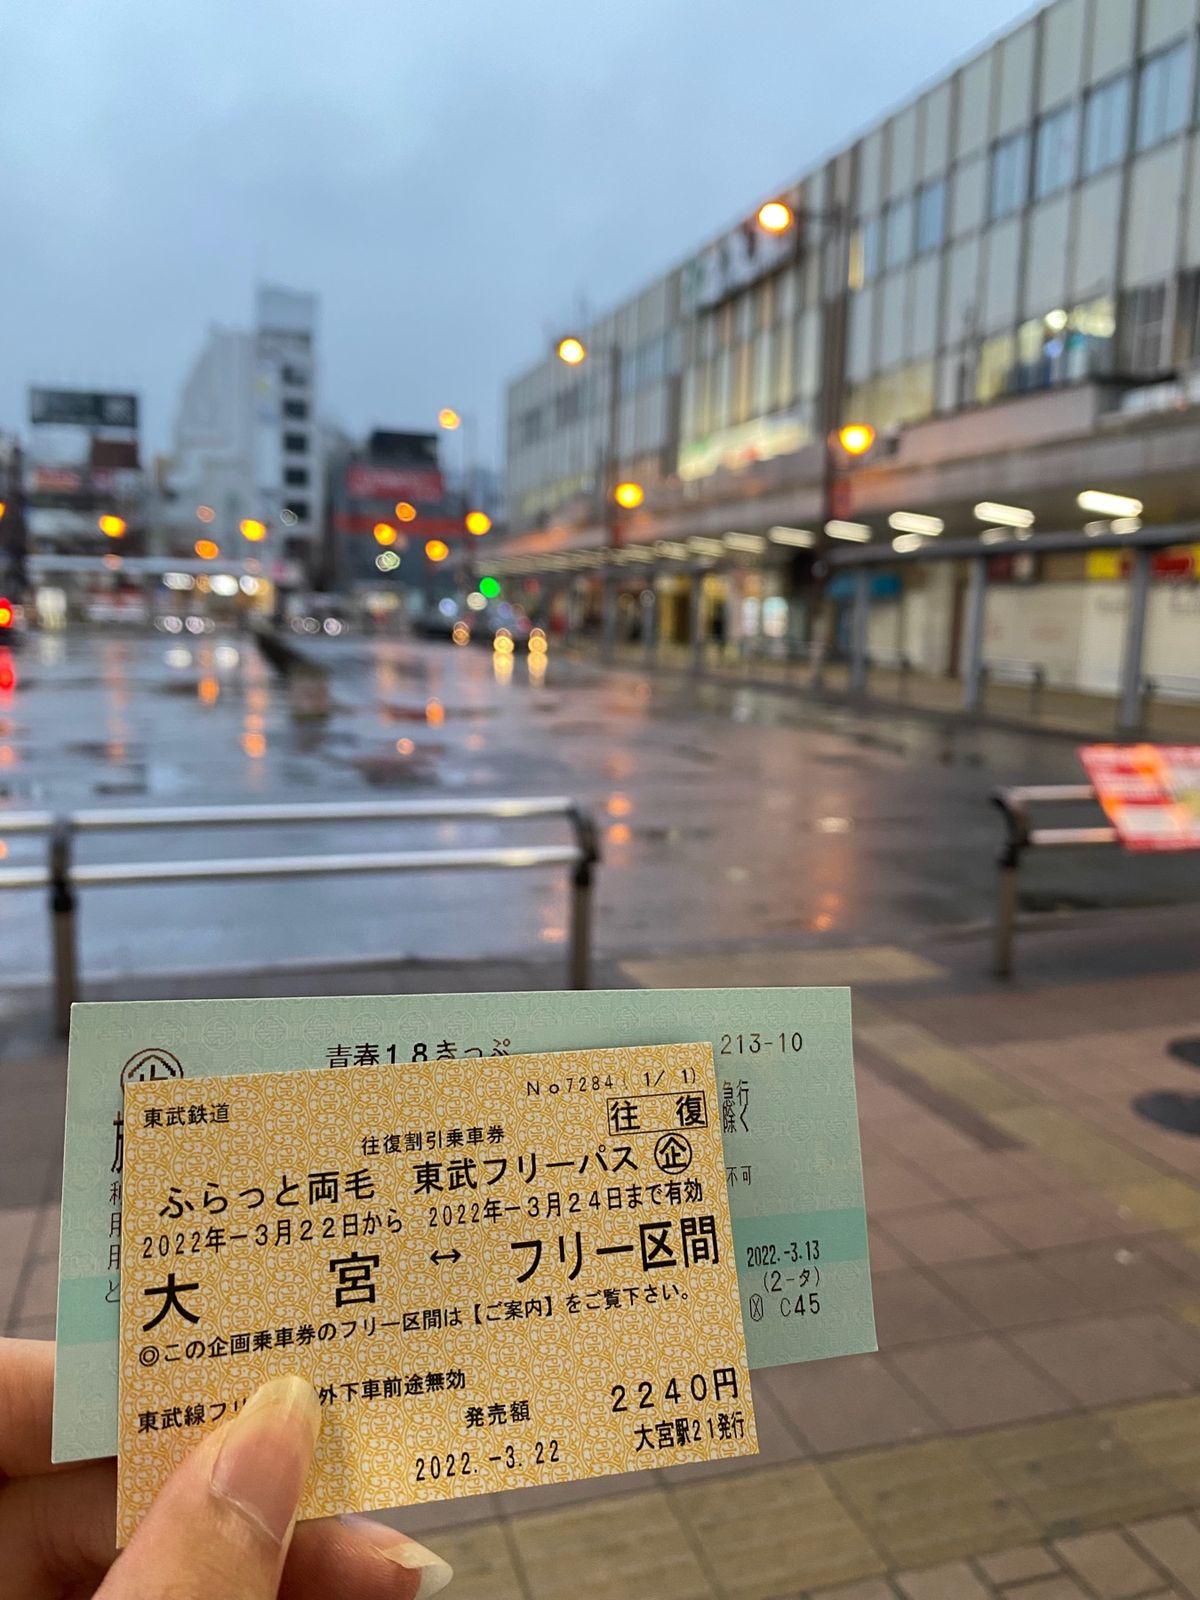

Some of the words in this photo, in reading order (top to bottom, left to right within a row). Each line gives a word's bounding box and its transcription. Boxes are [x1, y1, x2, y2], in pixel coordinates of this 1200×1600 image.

[721, 1032, 802, 1055] 213-10
[143, 1102, 230, 1129] 東武鉄道
[361, 1126, 505, 1156] 往復割引乗車券
[158, 1167, 376, 1219] ふらっと両毛
[412, 1144, 640, 1195] 東武フリーパス
[726, 1164, 752, 1188] 不可
[510, 1214, 721, 1284] フリー区間
[780, 1293, 820, 1318] C45
[610, 1366, 740, 1413] 2240円
[464, 1399, 531, 1429] 発売額
[633, 1411, 746, 1453] 大宮駅21発行
